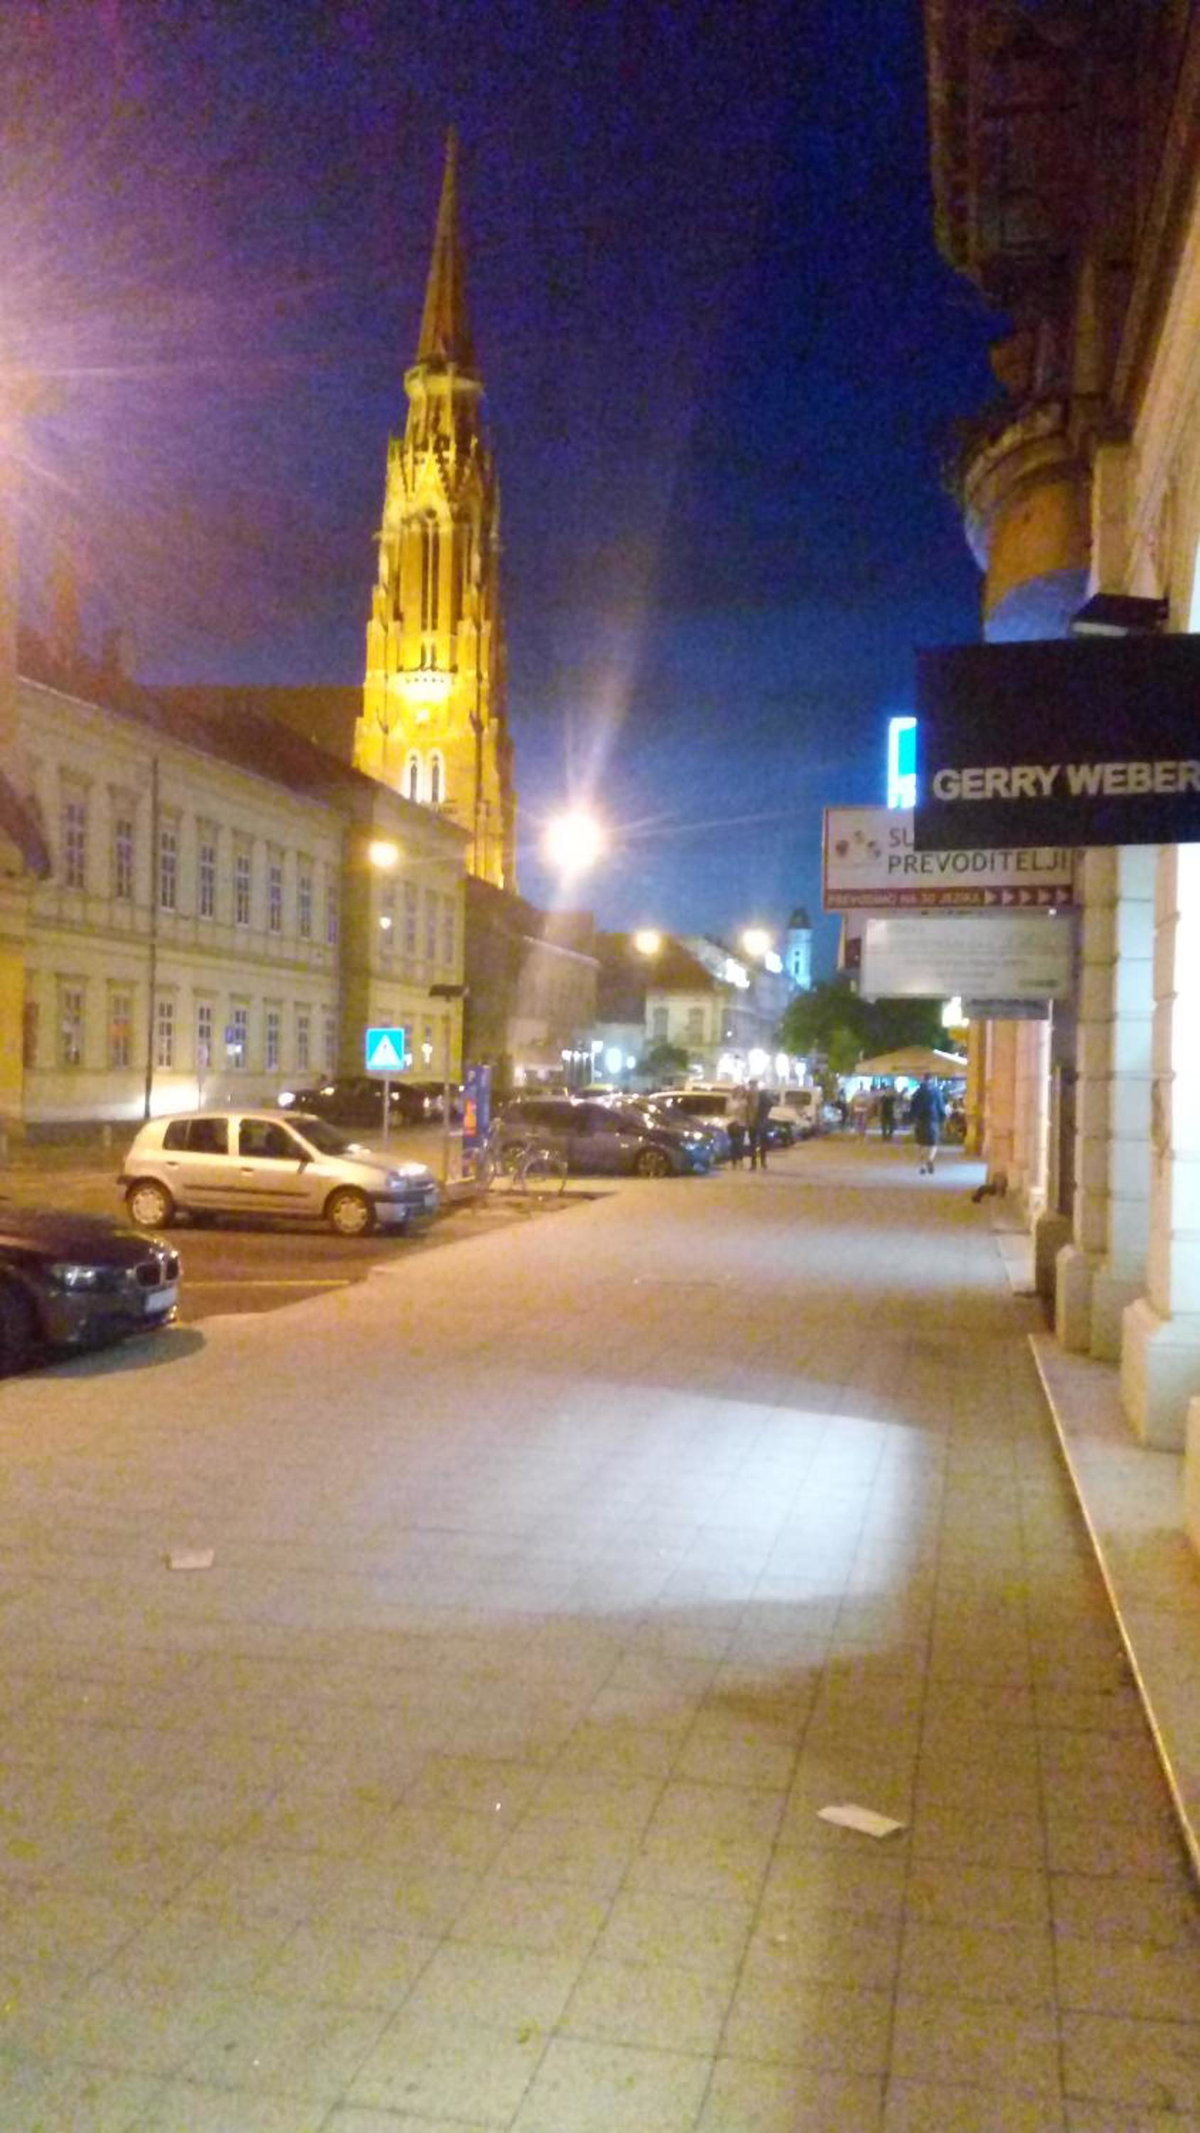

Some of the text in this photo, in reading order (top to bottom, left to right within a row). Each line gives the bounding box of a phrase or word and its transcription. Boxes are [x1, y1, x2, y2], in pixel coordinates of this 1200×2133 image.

[933, 760, 1200, 800] GERRY WEBER
[888, 850, 1067, 874] PREVODITELJI
